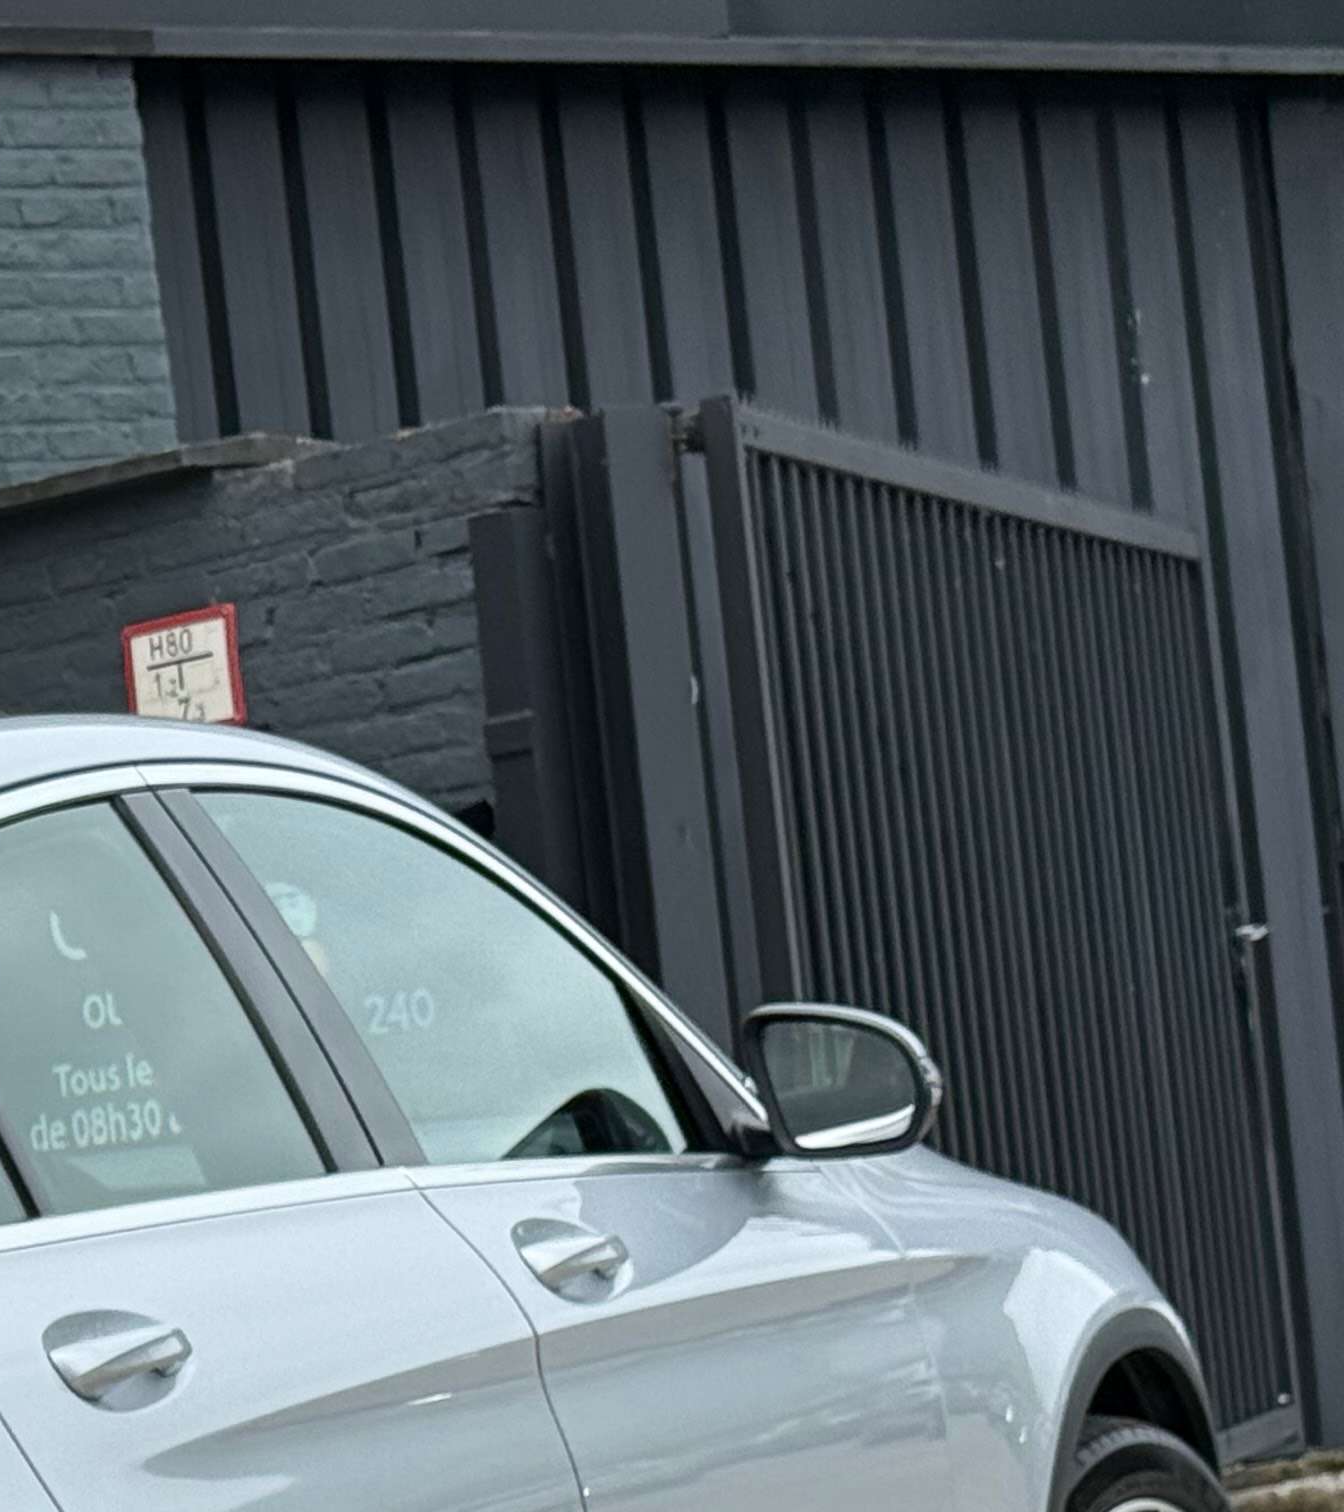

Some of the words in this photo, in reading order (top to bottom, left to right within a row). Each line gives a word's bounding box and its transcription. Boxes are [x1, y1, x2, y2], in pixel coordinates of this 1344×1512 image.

[148, 629, 193, 661] H80
[364, 988, 435, 1034] 240
[51, 1063, 121, 1097] Tous
[30, 1113, 67, 1151] de
[71, 1100, 161, 1147] 08h30
